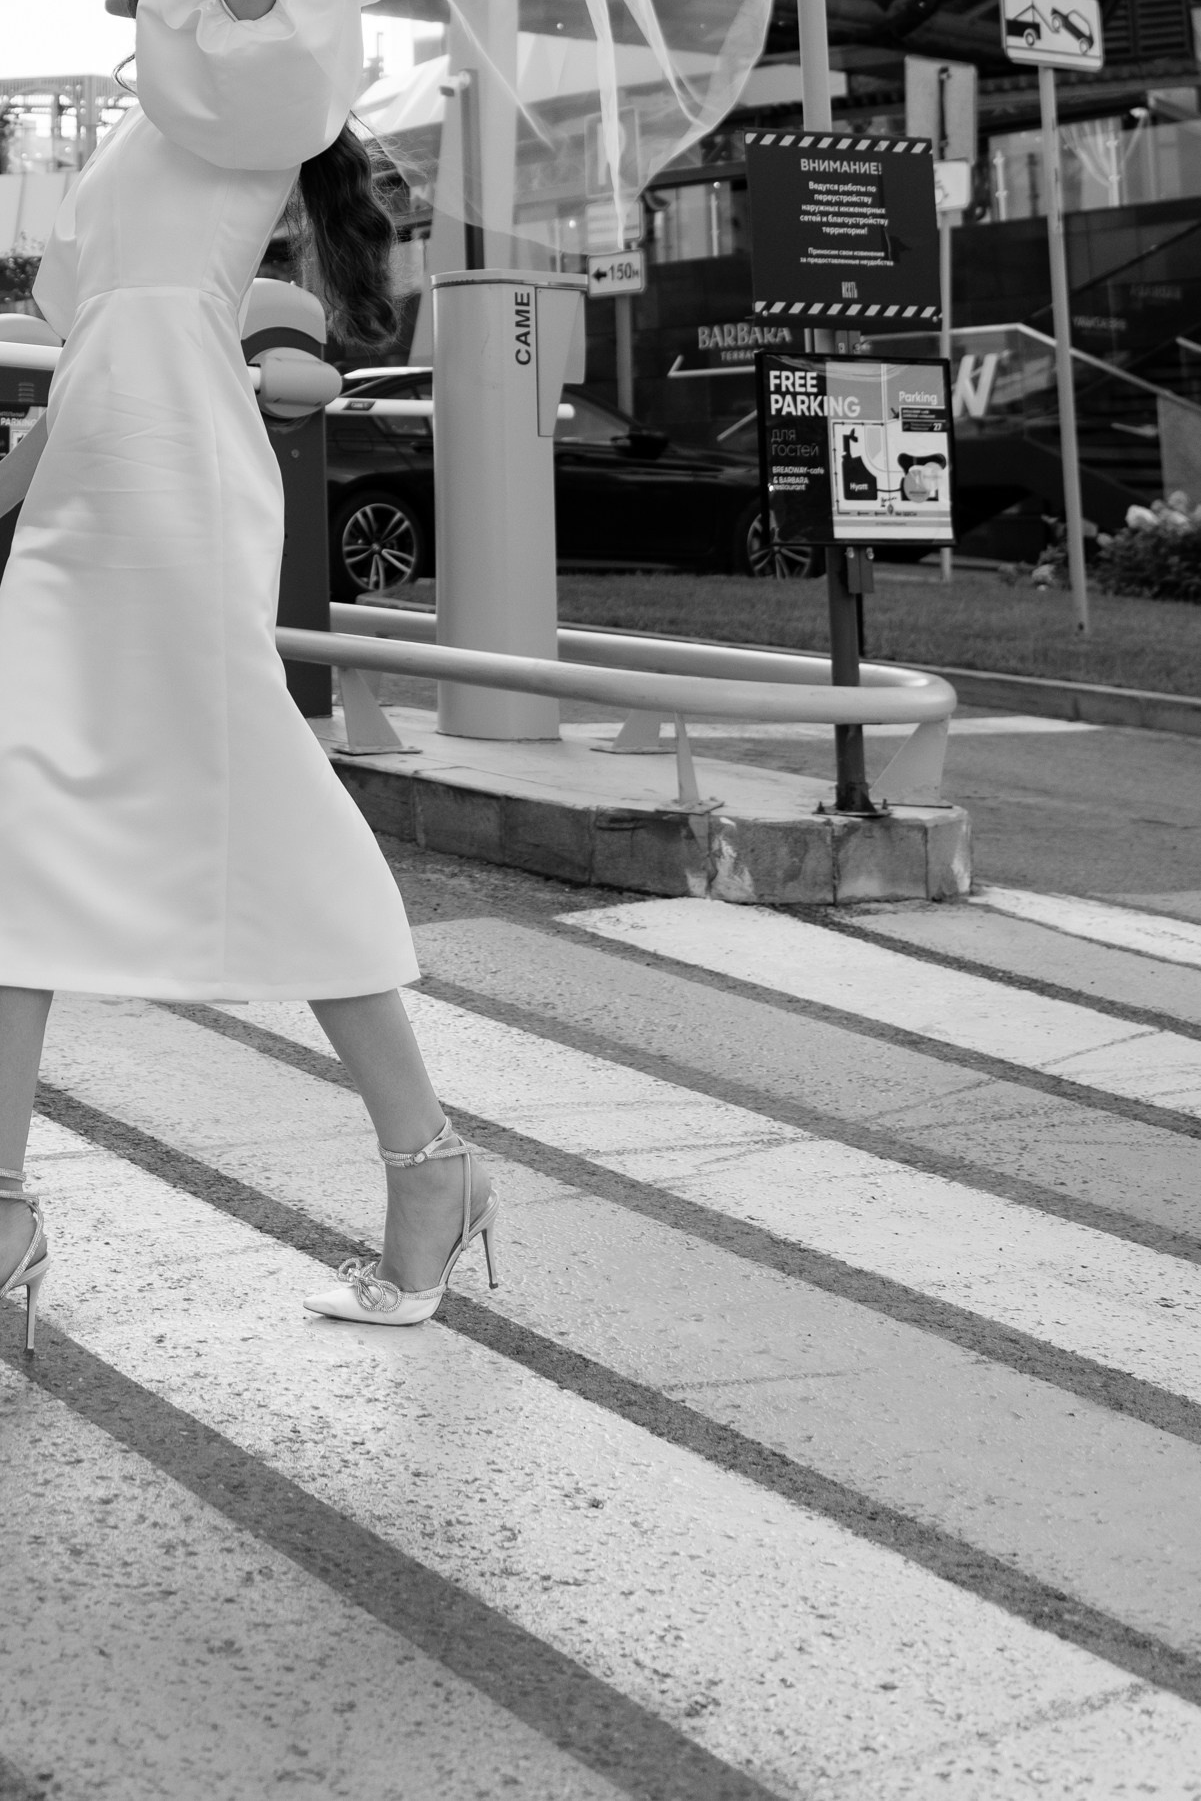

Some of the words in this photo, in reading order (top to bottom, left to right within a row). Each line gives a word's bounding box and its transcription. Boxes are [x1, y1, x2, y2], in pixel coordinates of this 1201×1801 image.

[800, 158, 882, 175] ВНИМАНИЕ!
[808, 181, 838, 192] Ведутся
[839, 183, 866, 192] работы
[813, 194, 872, 205] переустройству
[801, 204, 839, 212] наружных
[839, 206, 886, 215] инженерных
[800, 214, 821, 222] сетей
[827, 214, 888, 227] благоустройству
[821, 226, 868, 235] территории!
[514, 292, 532, 366] CAME
[698, 322, 792, 349] BARBARA
[769, 370, 818, 392] FREE
[899, 391, 937, 405] Parking
[770, 394, 861, 417] PARKING
[771, 429, 796, 443] для
[771, 443, 819, 456] гостей
[779, 476, 809, 484] BARBARA
[850, 482, 868, 492] Hyatt
